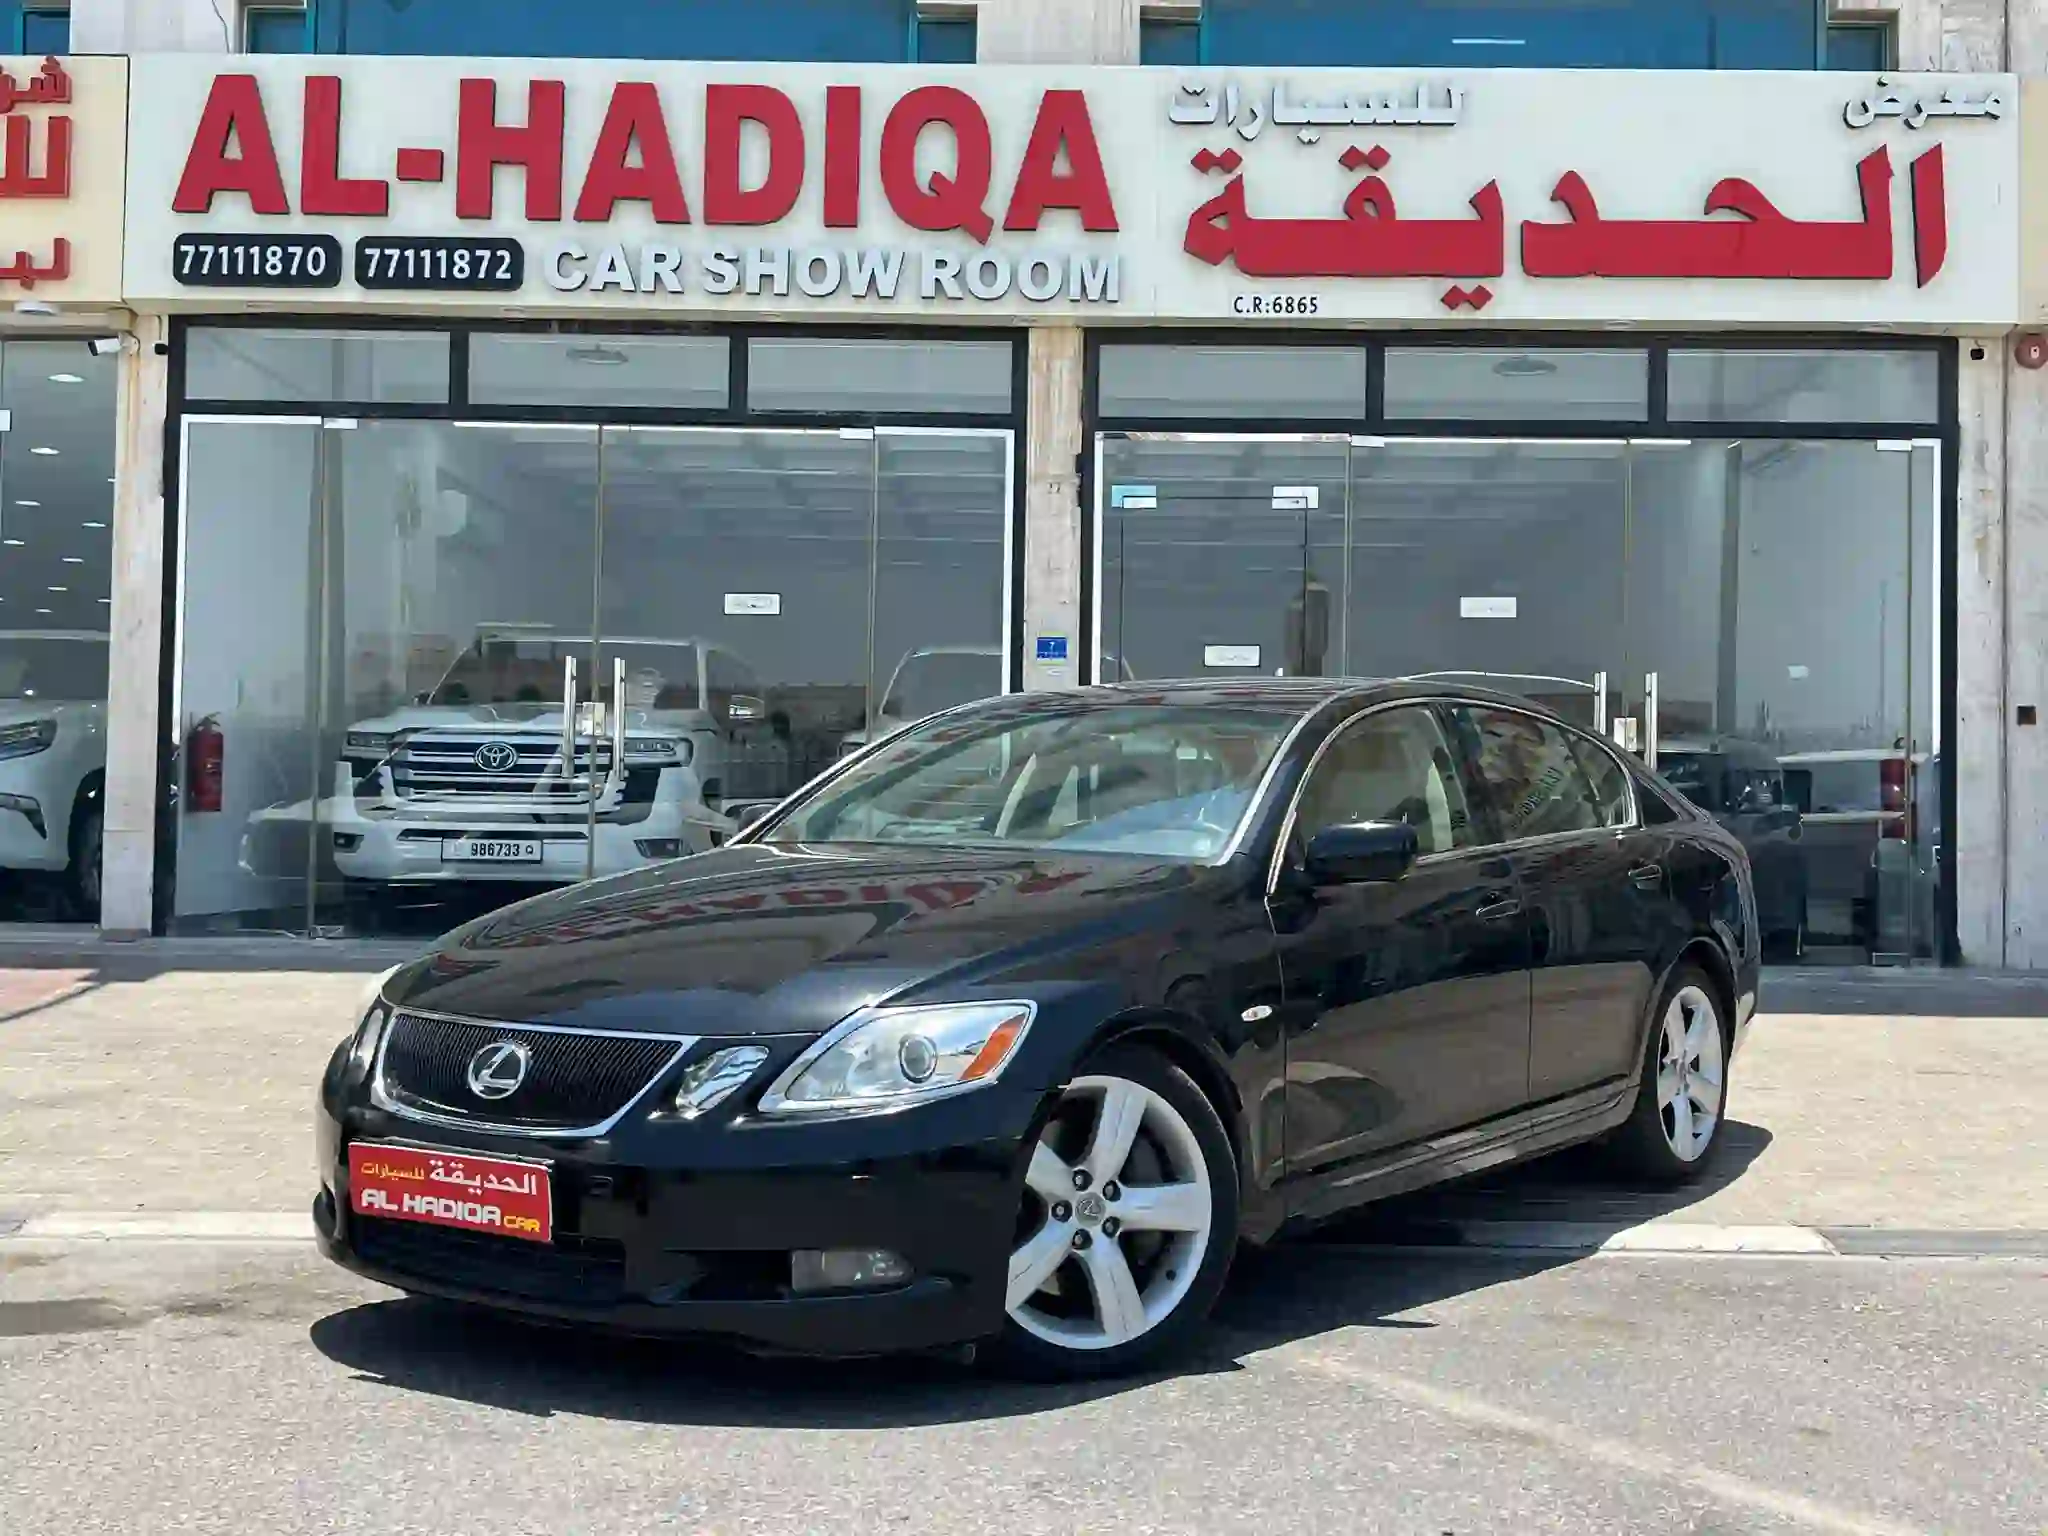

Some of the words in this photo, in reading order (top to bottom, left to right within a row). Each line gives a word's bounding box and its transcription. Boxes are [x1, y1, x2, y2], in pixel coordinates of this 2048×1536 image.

[1169, 82, 1465, 144] للسيارات
[1842, 75, 2001, 129] معرض
[173, 74, 1119, 243] AL-HADIQA
[1184, 143, 1947, 308] الحديقة
[179, 244, 327, 277] 77111870
[364, 247, 513, 281] 77111872
[543, 243, 685, 293] CAR
[701, 247, 906, 299] SHOW
[920, 250, 1120, 303] ROOM
[1233, 295, 1319, 314] C.R:6865
[360, 1161, 426, 1181] للسيارات
[429, 1158, 538, 1196] الحديقة
[360, 1187, 399, 1212] AL
[503, 1214, 541, 1233] CAR
